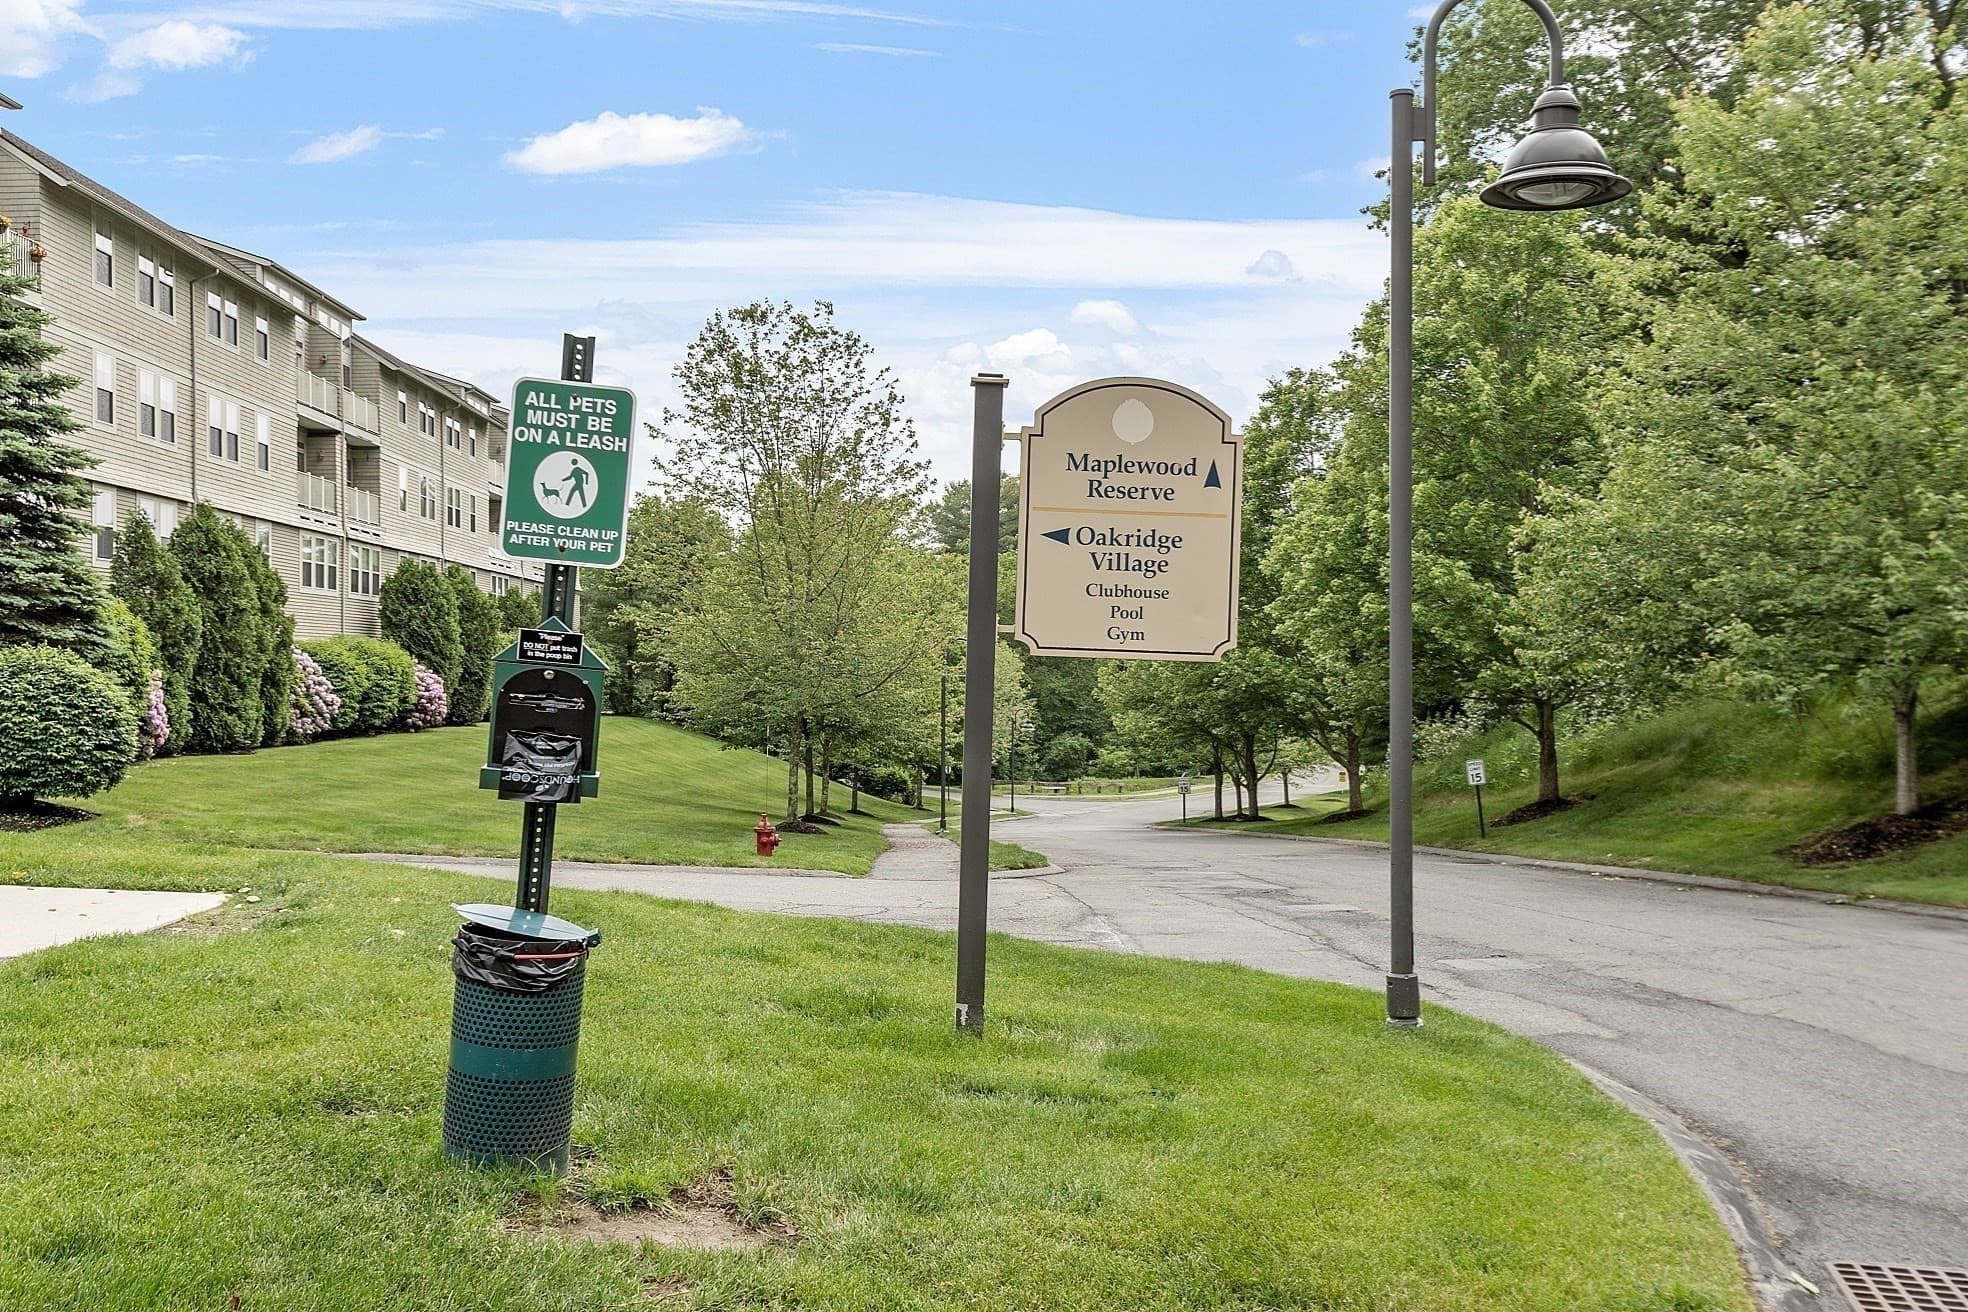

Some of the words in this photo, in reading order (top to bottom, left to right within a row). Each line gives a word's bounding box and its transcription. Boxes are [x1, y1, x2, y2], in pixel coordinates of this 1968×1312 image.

[524, 391, 561, 409] ALL
[568, 396, 617, 415] PETS
[526, 409, 580, 429] MUST
[587, 415, 613, 433] BE
[514, 426, 542, 443] ON
[546, 430, 560, 445] A
[565, 431, 627, 452] LEASH
[1065, 452, 1198, 480] Maplewood
[1086, 479, 1175, 501] Reserve
[506, 520, 555, 535] PLEASE
[557, 525, 599, 539] CLEAN
[601, 530, 619, 540] UP
[1076, 526, 1183, 554] Oakridge
[509, 533, 550, 547] AFTER
[552, 537, 586, 551] YOUR
[590, 541, 614, 553] PET
[1089, 552, 1169, 578] Village
[1085, 583, 1169, 600] Clubhouse
[1110, 605, 1144, 620] Pool
[1107, 626, 1145, 644] Gym
[523, 641, 534, 649] DO
[534, 642, 549, 651] NOT
[1470, 772, 1482, 782] 15
